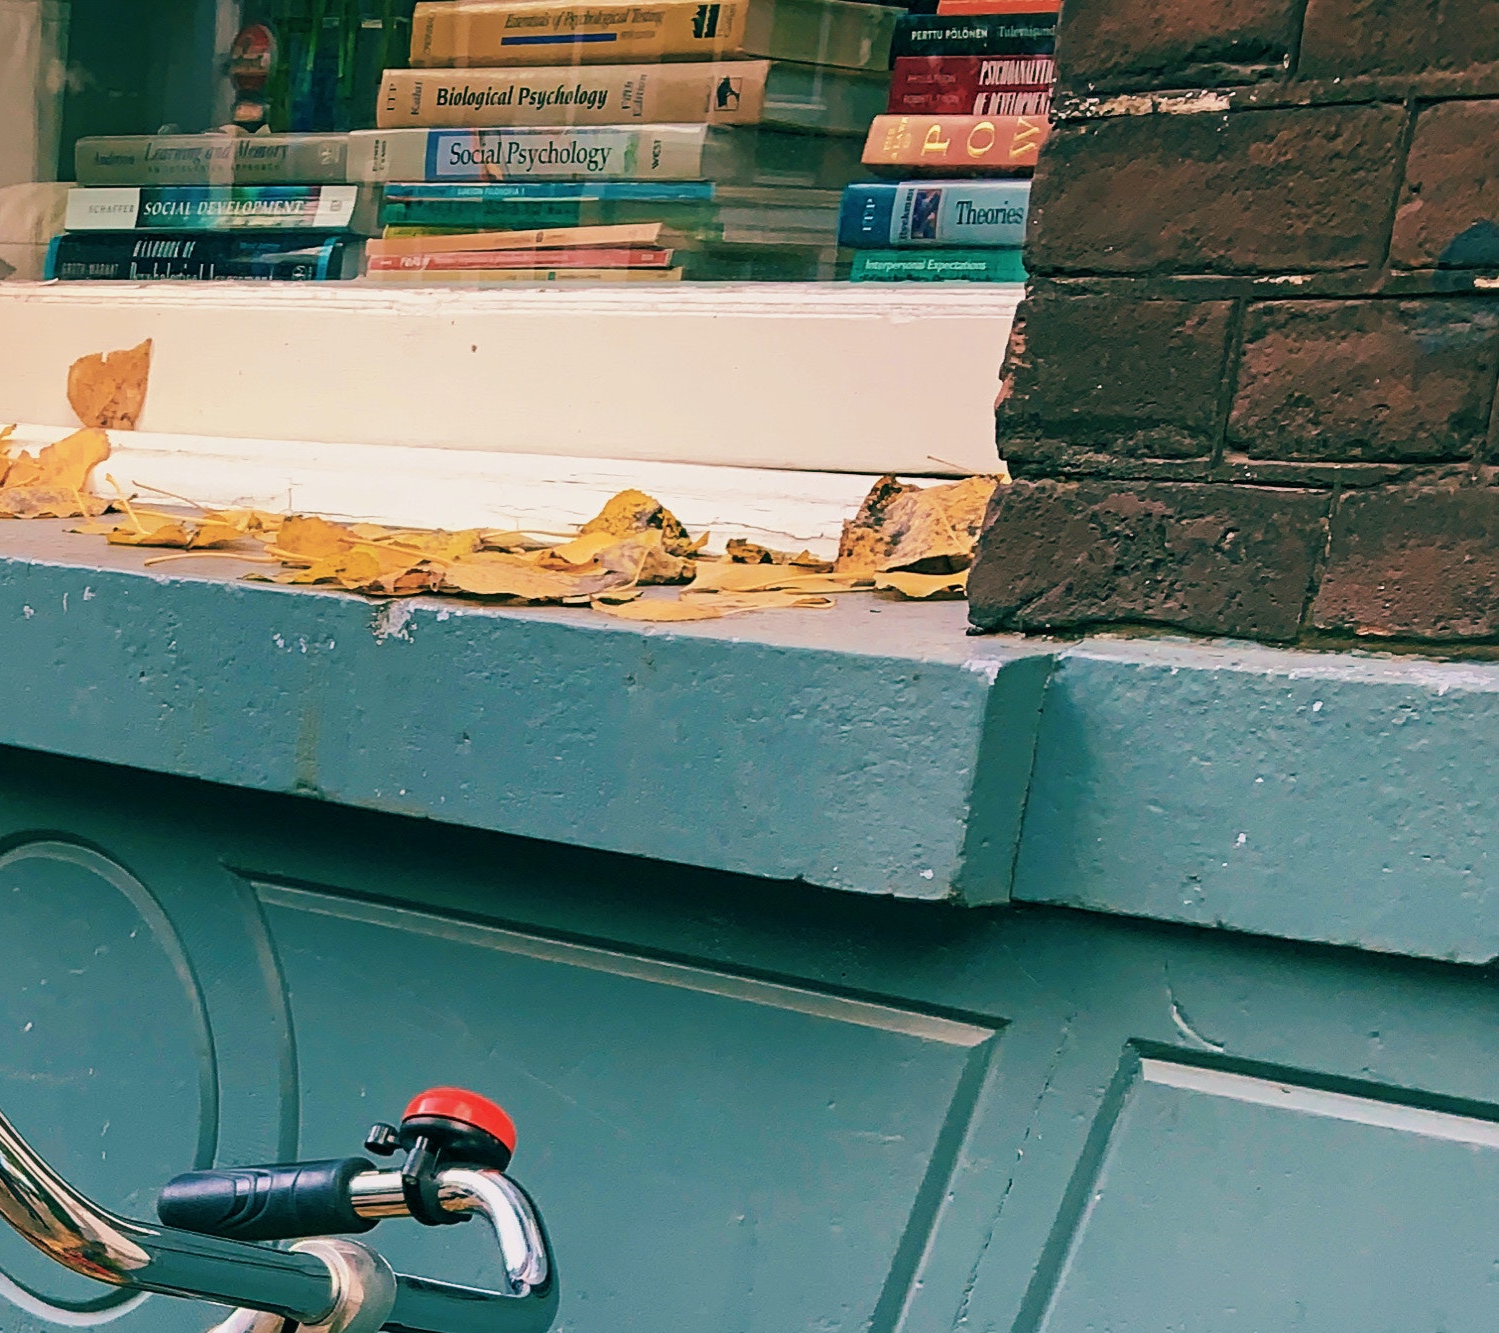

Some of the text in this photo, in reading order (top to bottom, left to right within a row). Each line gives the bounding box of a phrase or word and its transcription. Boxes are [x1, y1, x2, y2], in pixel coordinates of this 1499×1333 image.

[911, 30, 943, 41] PERTTU
[436, 84, 608, 110] Biological Psychology
[449, 140, 612, 172] Social Psychology
[651, 139, 663, 170] WEST
[88, 203, 135, 214] SCHAFFER
[143, 200, 304, 217] SOCIAL DEVELOPMENT
[955, 200, 1025, 225] Theories
[865, 258, 987, 273] Interpersonal Expectations
